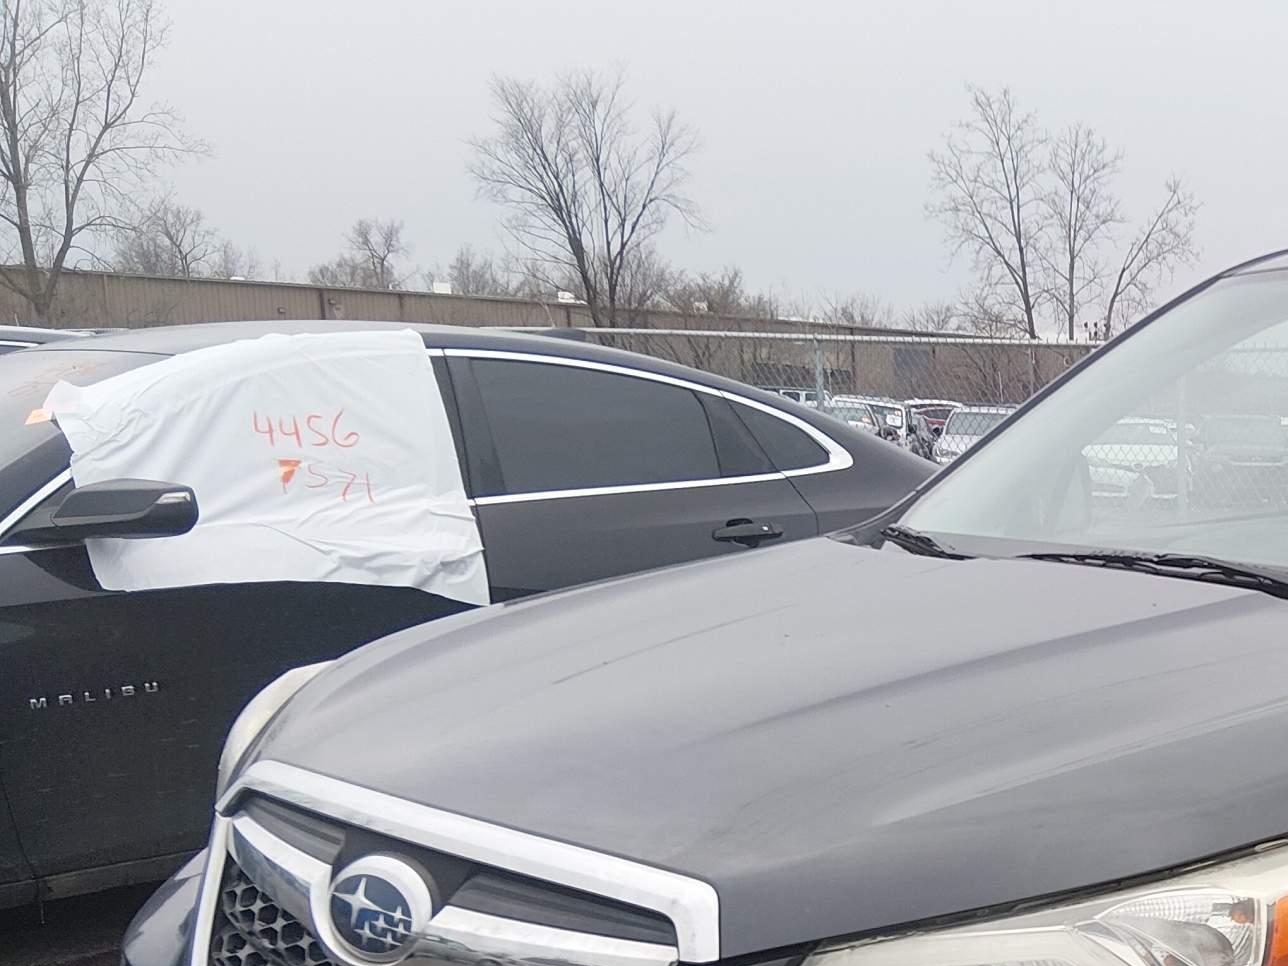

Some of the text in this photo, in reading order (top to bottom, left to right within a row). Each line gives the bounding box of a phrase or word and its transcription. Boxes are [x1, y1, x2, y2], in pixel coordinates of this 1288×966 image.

[254, 408, 361, 449] 4456
[276, 459, 376, 504] 7571
[29, 681, 159, 710] MALIBU
